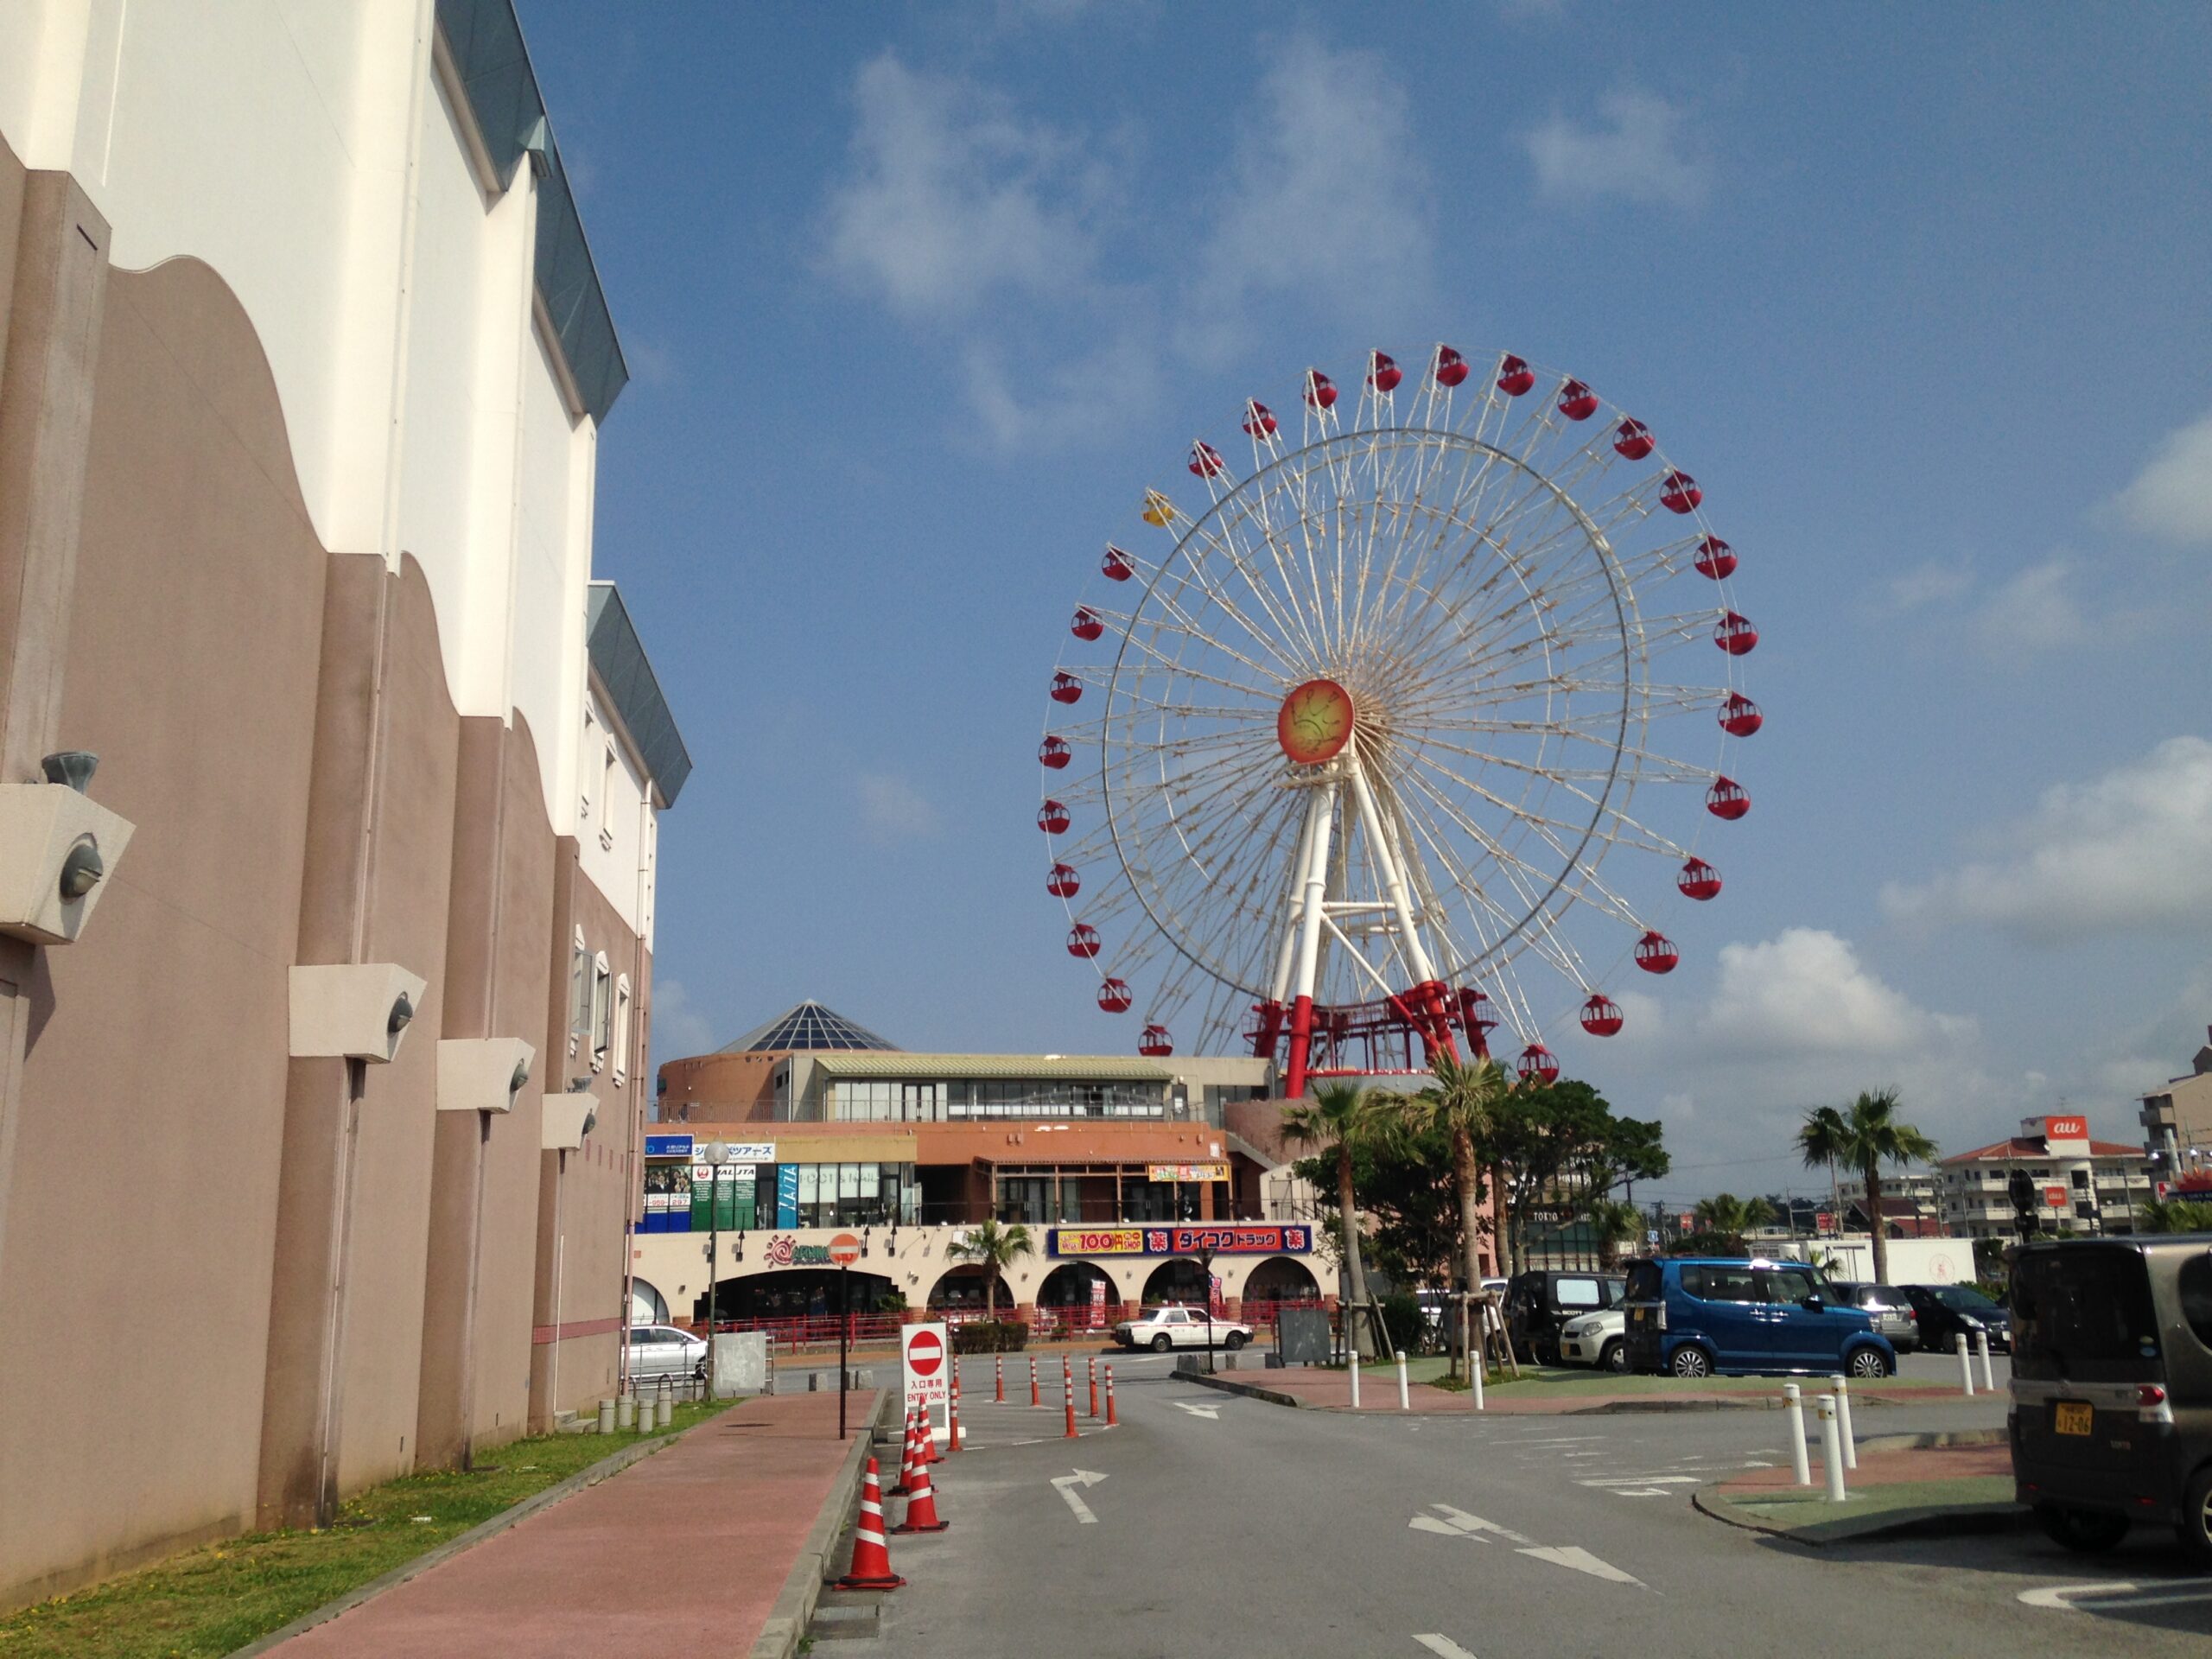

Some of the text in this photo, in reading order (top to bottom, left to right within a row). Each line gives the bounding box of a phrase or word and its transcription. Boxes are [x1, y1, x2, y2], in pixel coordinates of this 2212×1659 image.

[2053, 1122, 2081, 1134] au
[694, 1145, 772, 1156] ジツアーズ
[1534, 1211, 1559, 1222] TOKYO
[1123, 1241, 1141, 1250] SHOP
[911, 1379, 942, 1389] 入口専用
[930, 1390, 946, 1400] ONLY
